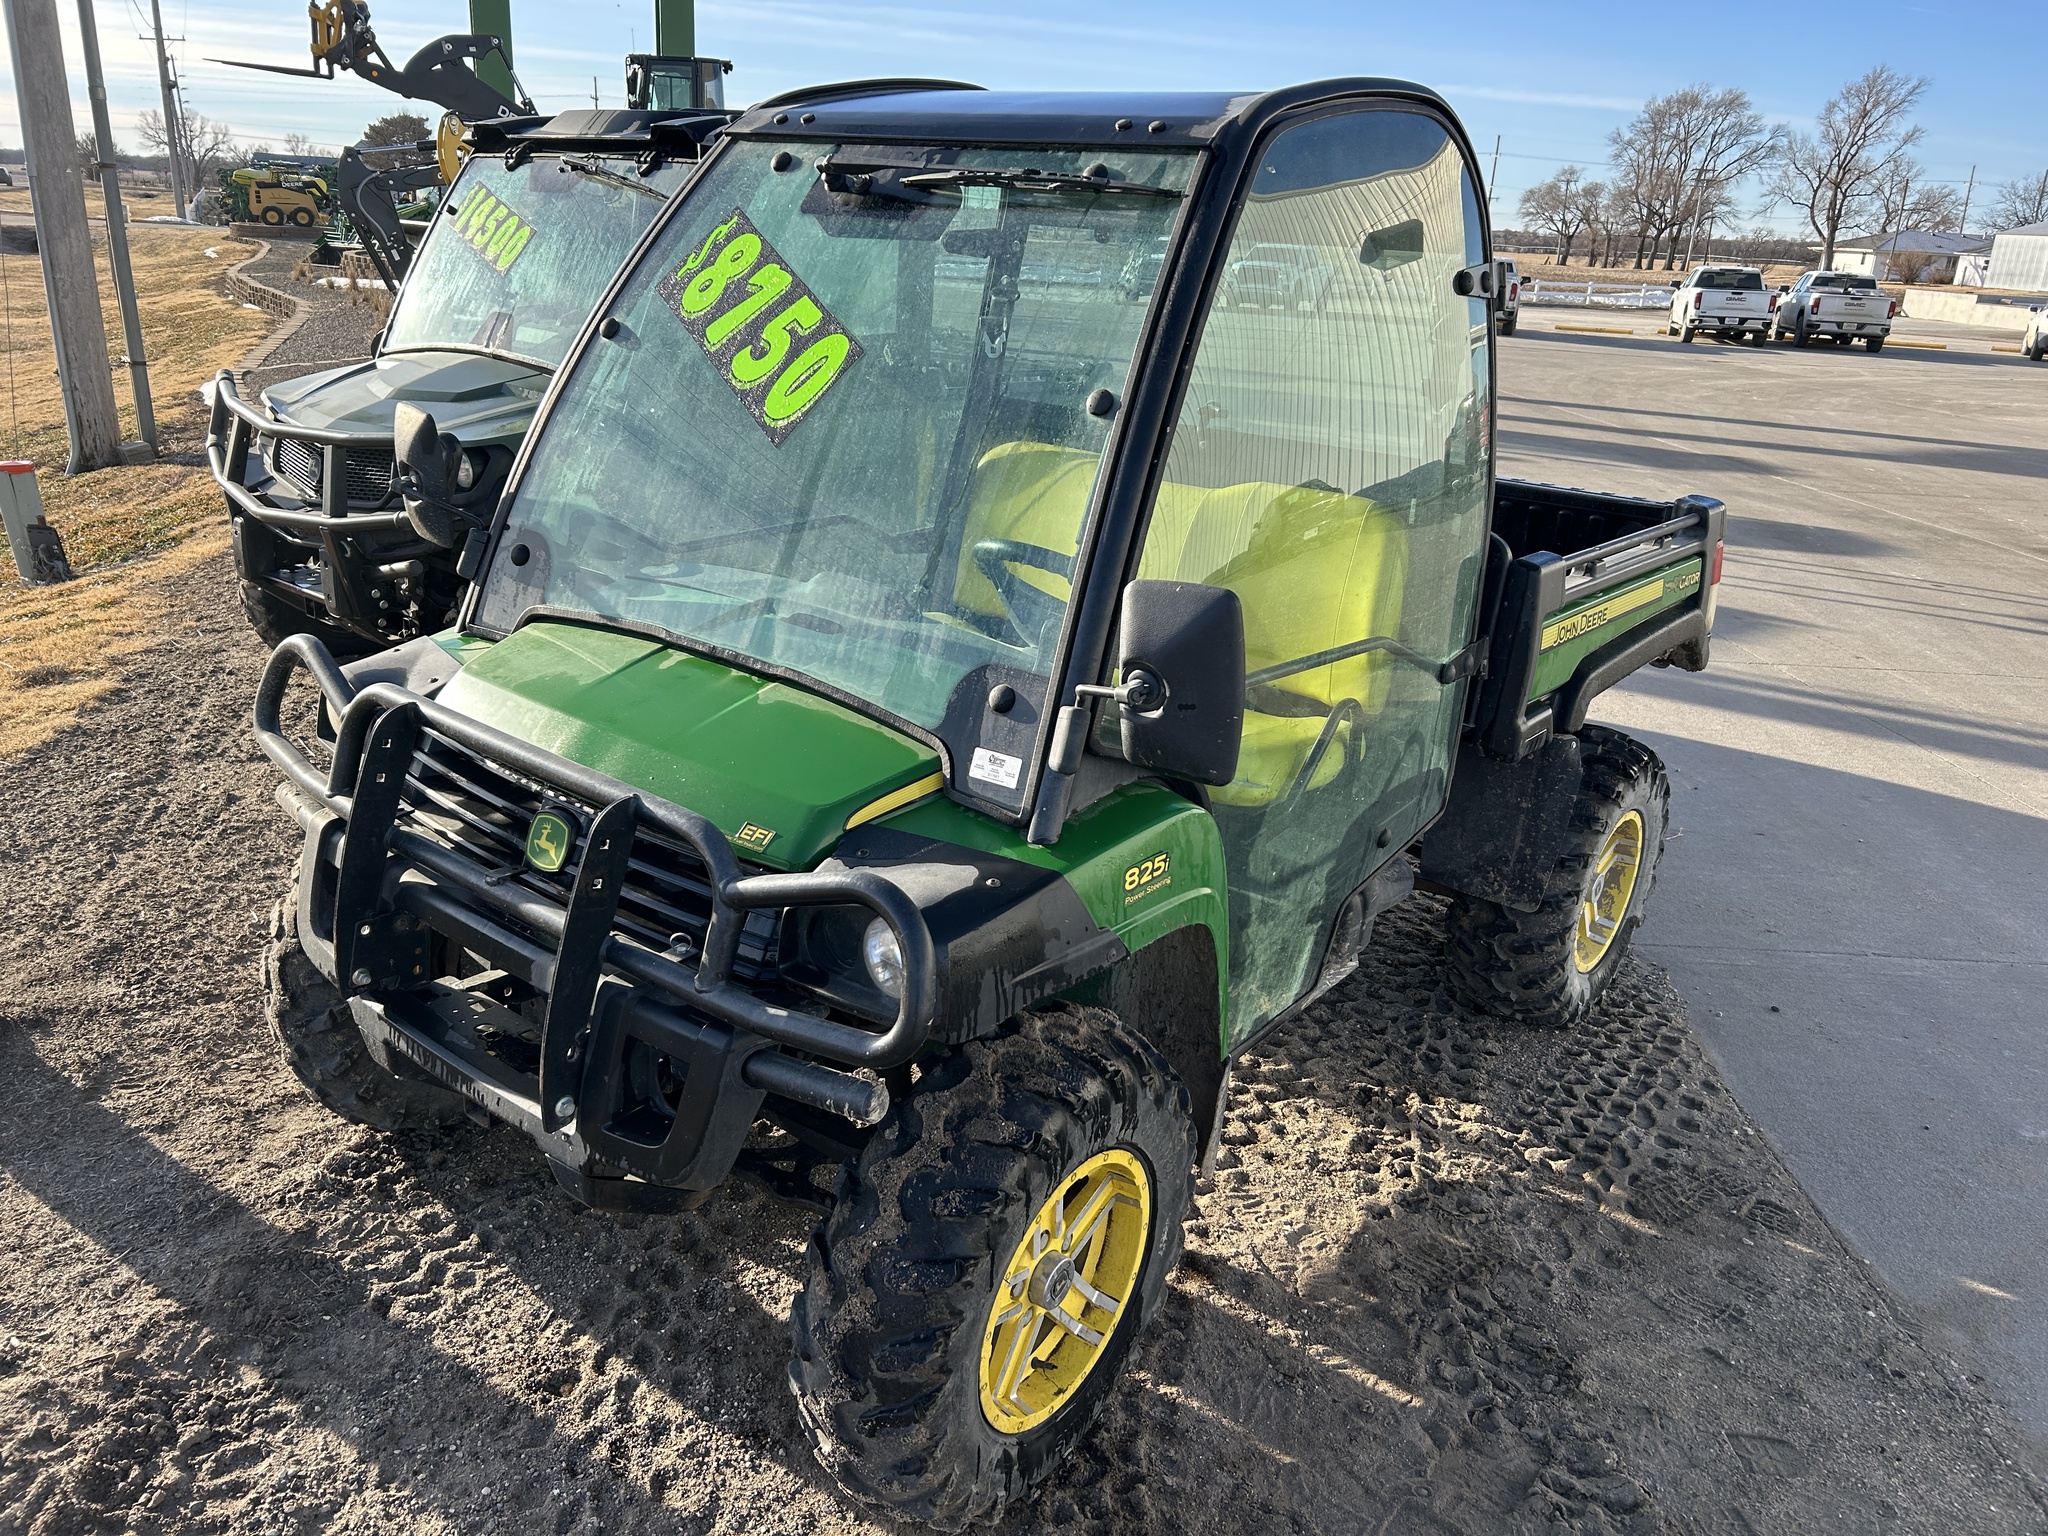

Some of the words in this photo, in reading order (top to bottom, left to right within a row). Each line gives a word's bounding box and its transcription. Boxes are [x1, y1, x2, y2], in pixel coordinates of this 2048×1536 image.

[676, 215, 851, 426] $8750
[1679, 571, 1700, 590] GATOR
[1553, 619, 1580, 645] JOHN
[1580, 607, 1608, 632] DEERE
[740, 824, 773, 846] EFI
[1124, 853, 1170, 891] 825i
[1124, 890, 1145, 906] Power
[1146, 876, 1171, 895] Steering
